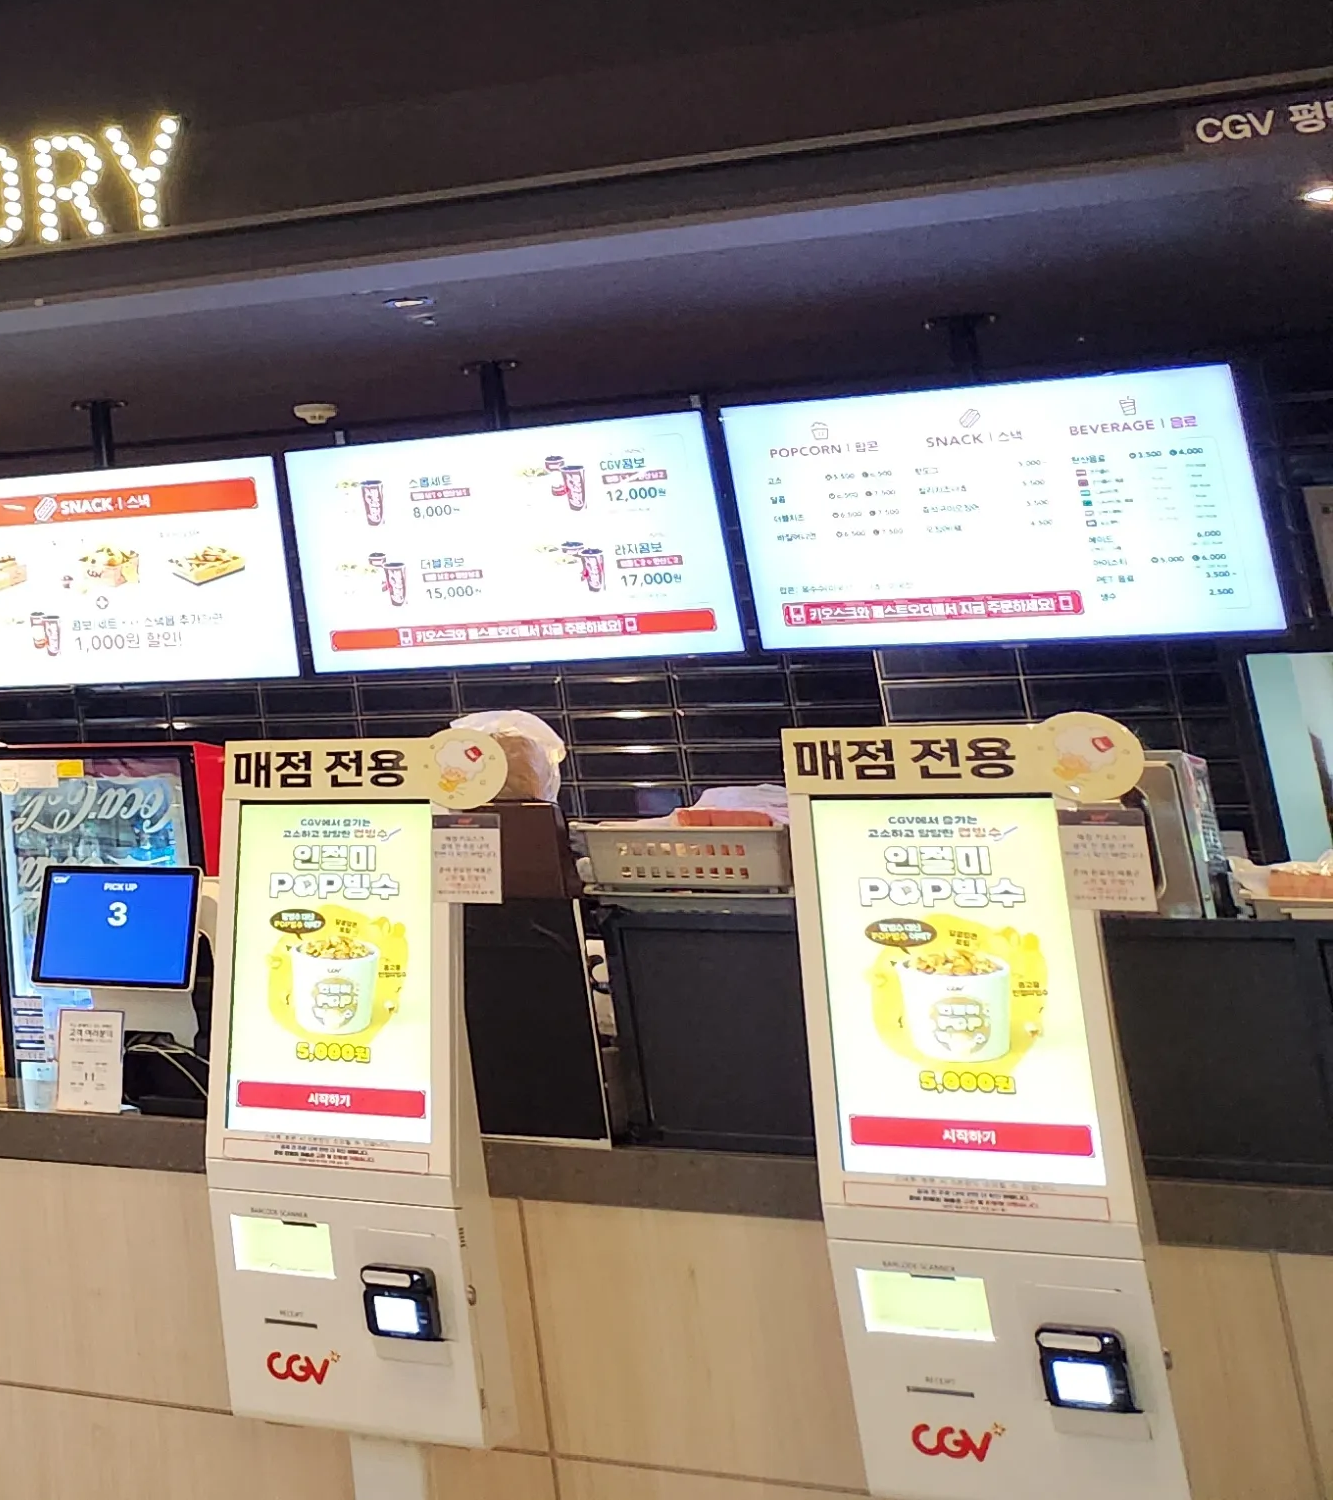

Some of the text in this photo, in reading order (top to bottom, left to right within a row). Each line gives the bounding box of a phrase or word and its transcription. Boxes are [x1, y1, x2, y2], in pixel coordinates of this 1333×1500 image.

[1195, 100, 1333, 143] CGV 평
[926, 430, 1024, 448] SNACK 스낵
[1069, 420, 1156, 436] BEVERAGE
[769, 444, 842, 458] POPCORN
[60, 499, 114, 515] SNACK
[74, 631, 182, 653] 1,000원 할인!
[234, 749, 408, 788] 매점 전용
[793, 736, 1016, 781] 매점 전용
[293, 845, 376, 871] 인절미
[884, 846, 992, 875] 인절미
[104, 883, 138, 892] PICK UP
[269, 873, 400, 900] POP빙수
[858, 877, 1026, 908] POP빙수
[107, 901, 128, 927] 3
[296, 1042, 371, 1063] 5,000원
[919, 1070, 1017, 1095] 5,000원
[308, 1092, 351, 1107] 시작하기
[942, 1129, 997, 1145] 시작하기
[266, 1351, 329, 1384] CGV
[911, 1423, 992, 1462] CGV
